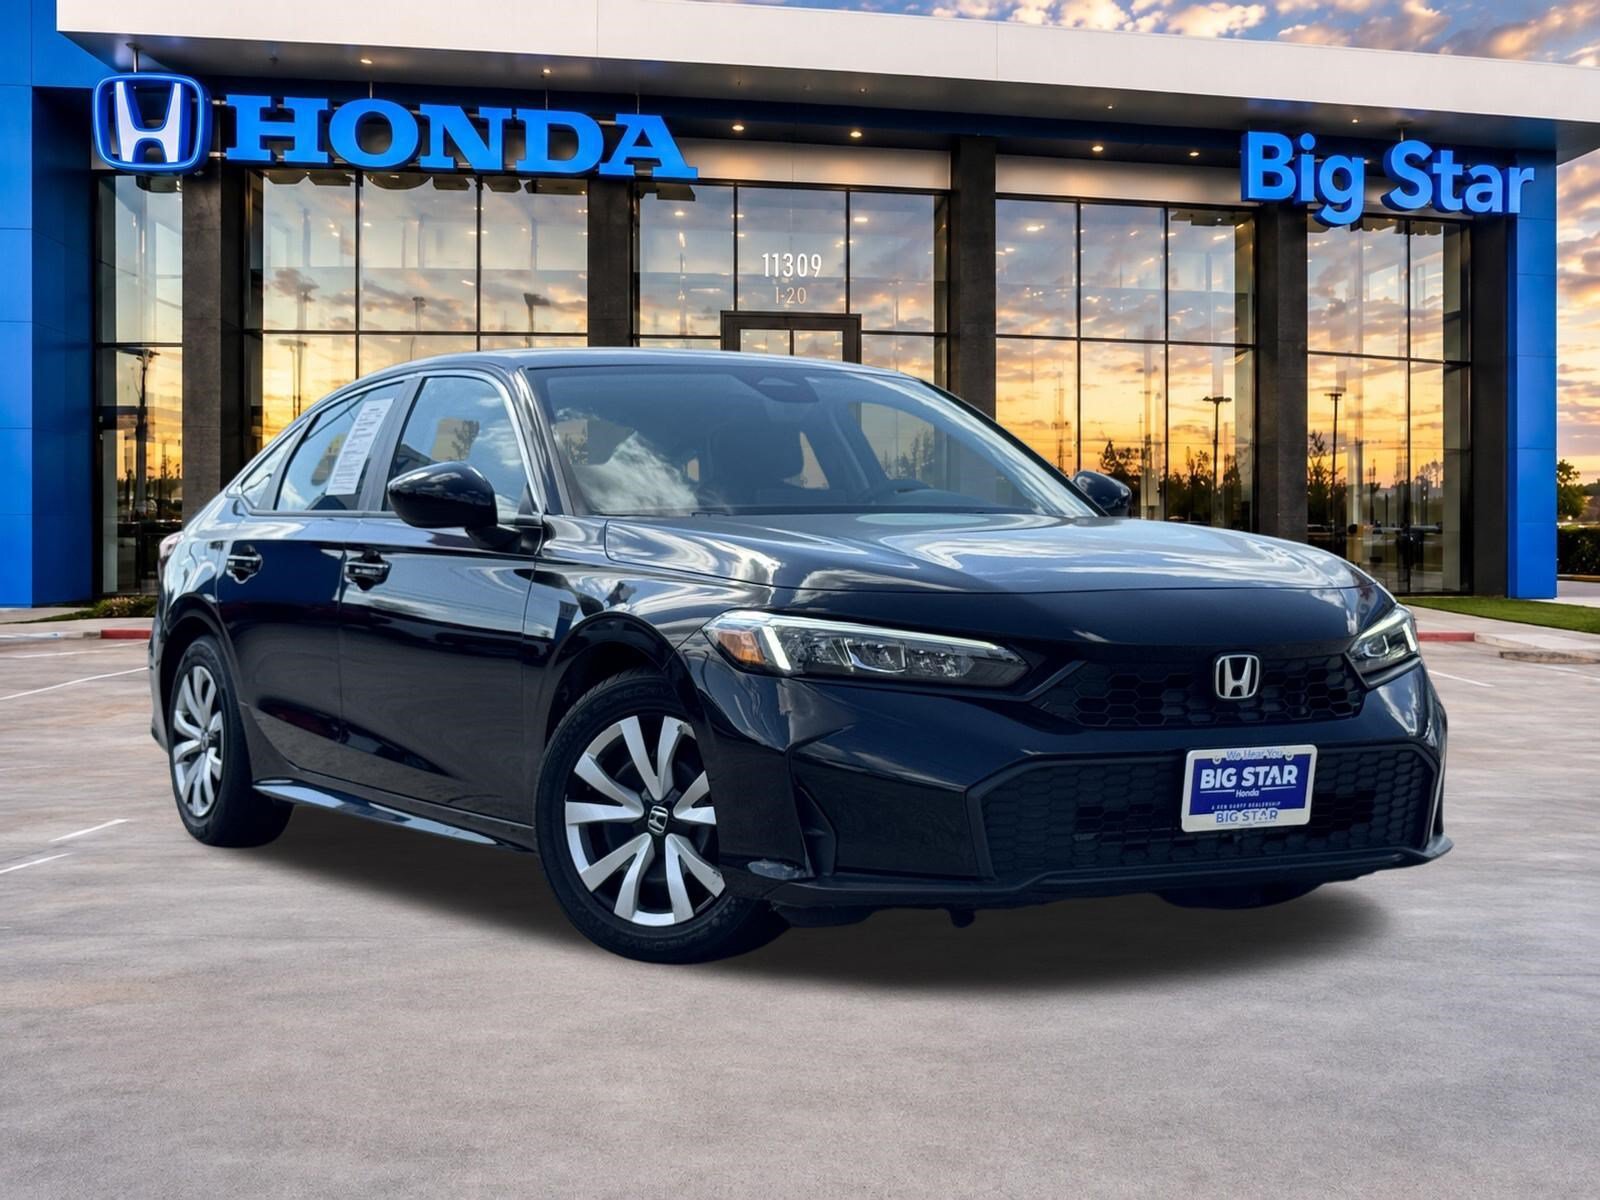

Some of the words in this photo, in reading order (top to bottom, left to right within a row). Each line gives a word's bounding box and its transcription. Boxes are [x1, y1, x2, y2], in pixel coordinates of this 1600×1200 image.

[226, 94, 698, 180] HONDA
[1241, 131, 1366, 226] Big
[1383, 139, 1535, 214] Star
[761, 252, 822, 278] 11309
[1267, 748, 1283, 758] You
[1200, 767, 1237, 790] BIG
[1241, 765, 1298, 787] STAR
[1235, 788, 1260, 798] Honda
[1216, 811, 1239, 823] BIG
[1242, 809, 1278, 821] STAR
